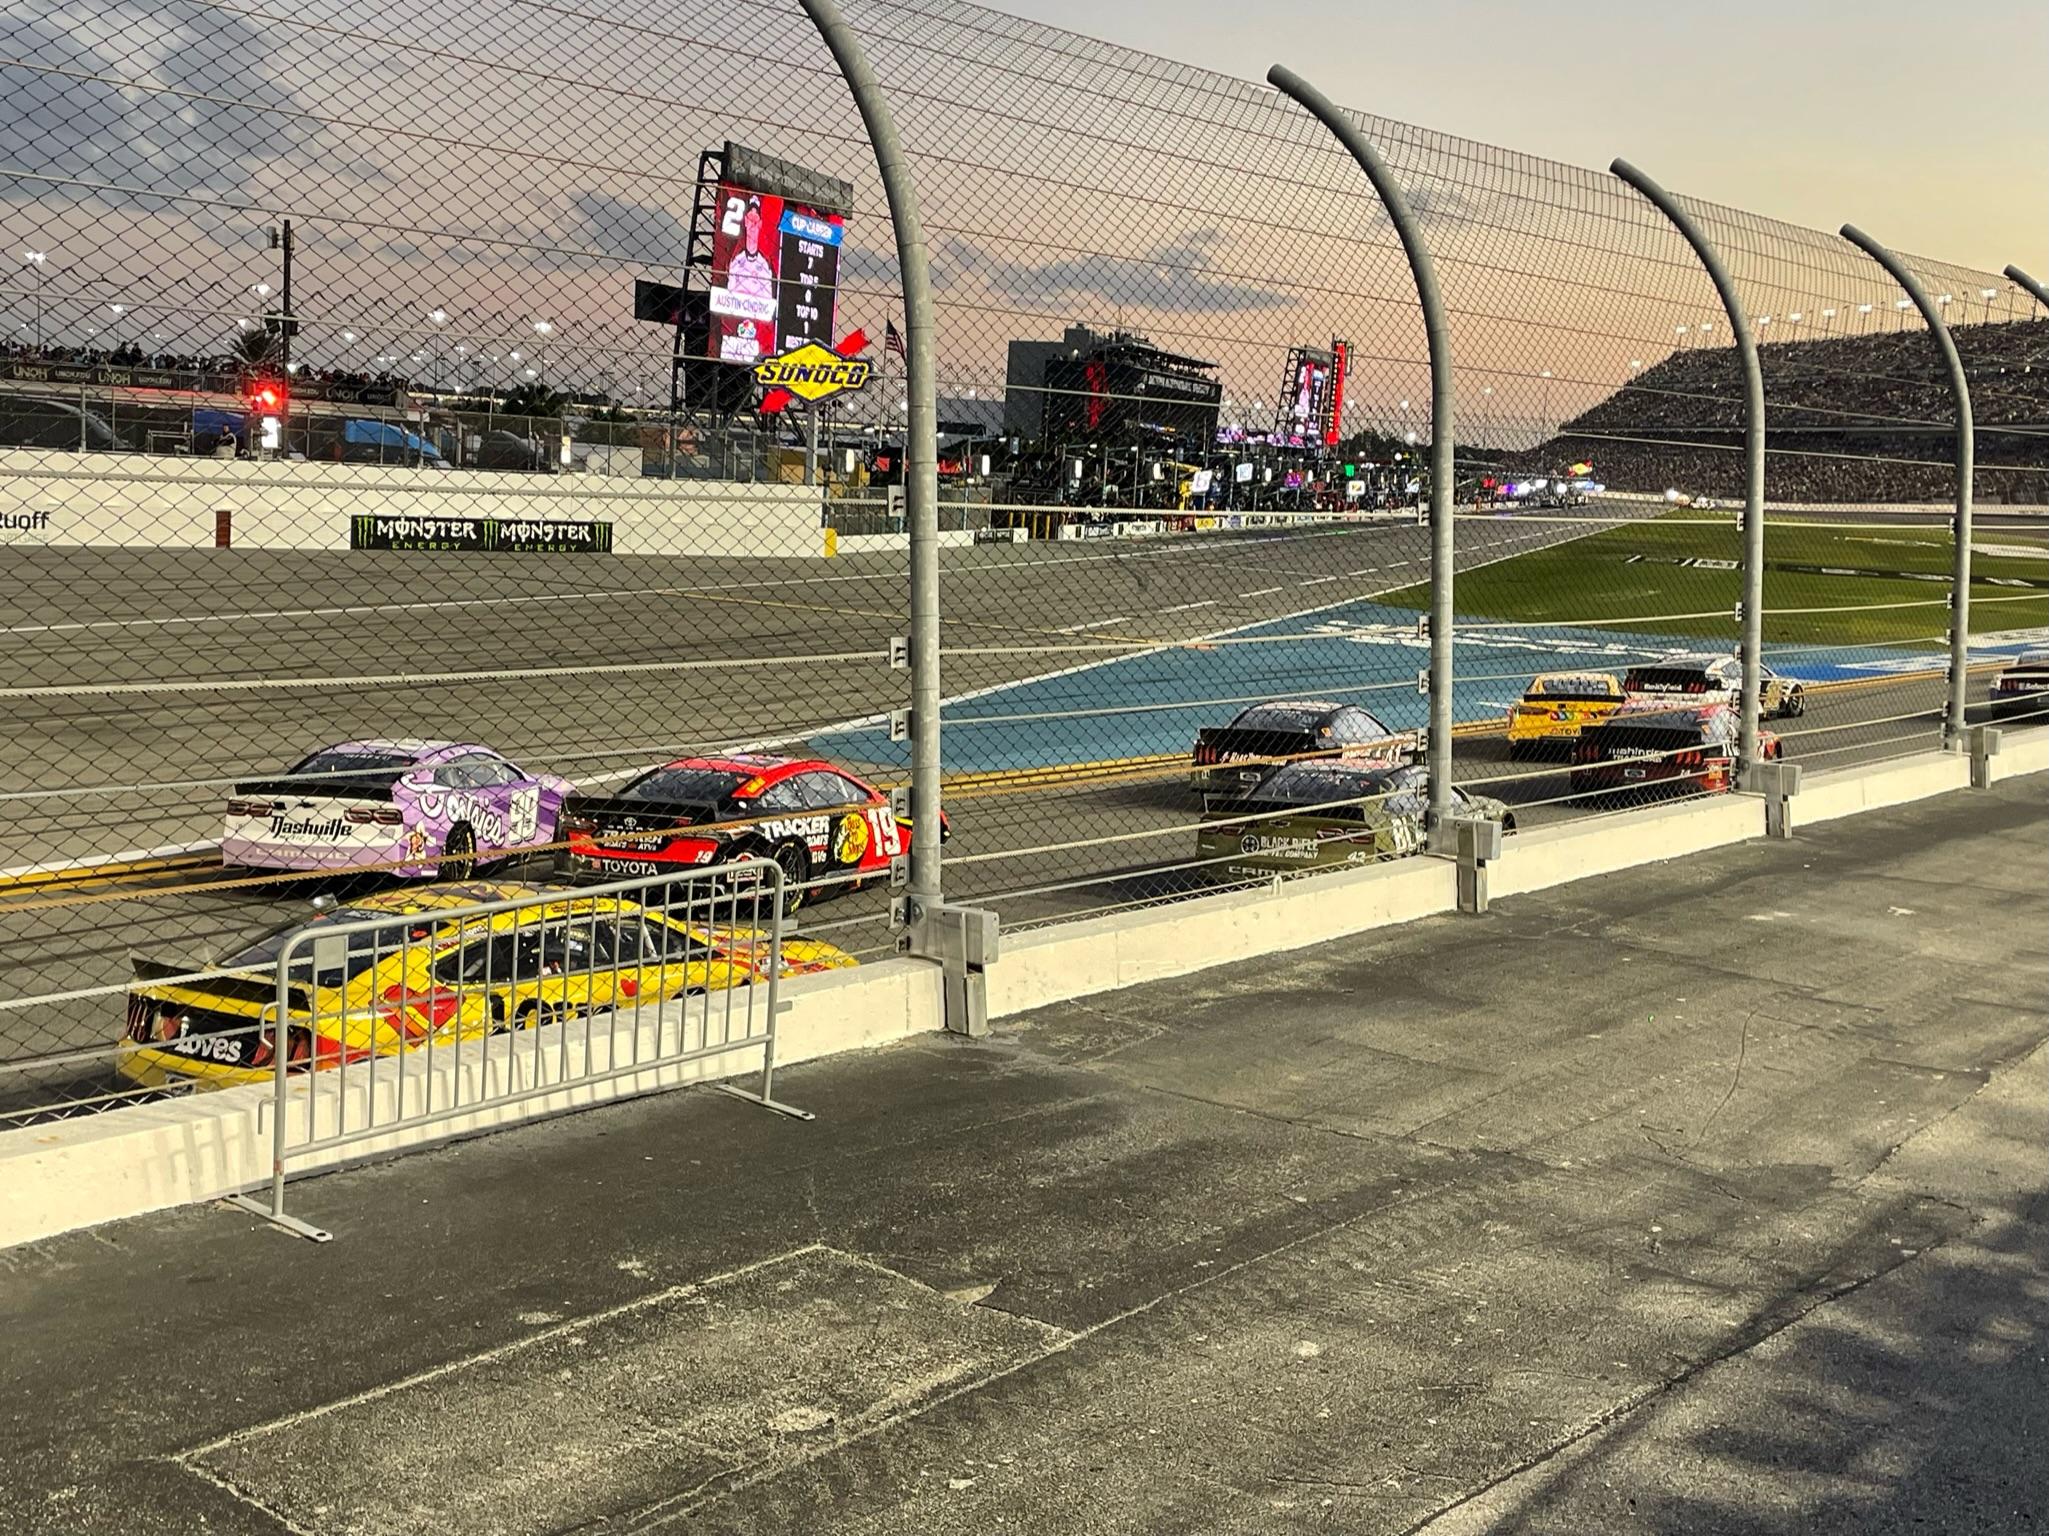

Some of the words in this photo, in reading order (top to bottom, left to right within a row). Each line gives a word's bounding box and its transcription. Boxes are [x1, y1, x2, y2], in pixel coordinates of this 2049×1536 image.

[722, 197, 745, 236] 2
[799, 240, 823, 258] STARTS
[716, 295, 742, 309] AUSTIN
[796, 304, 810, 319] TOP
[810, 308, 818, 320] 10
[12, 366, 48, 380] UNOH
[98, 372, 131, 384] UNOH
[760, 360, 866, 385] SUNOCO
[0, 511, 49, 529] uoff
[376, 517, 477, 540] MONSTER
[500, 520, 592, 542] MONSTER
[391, 540, 462, 550] ENERGY
[514, 543, 578, 553] ENERGY
[271, 816, 352, 842] Nashville
[758, 814, 832, 843] TRACKER
[867, 807, 902, 857] 19
[1260, 835, 1290, 851] BLACK
[694, 850, 714, 864] 19
[602, 858, 659, 876] TOYOTA
